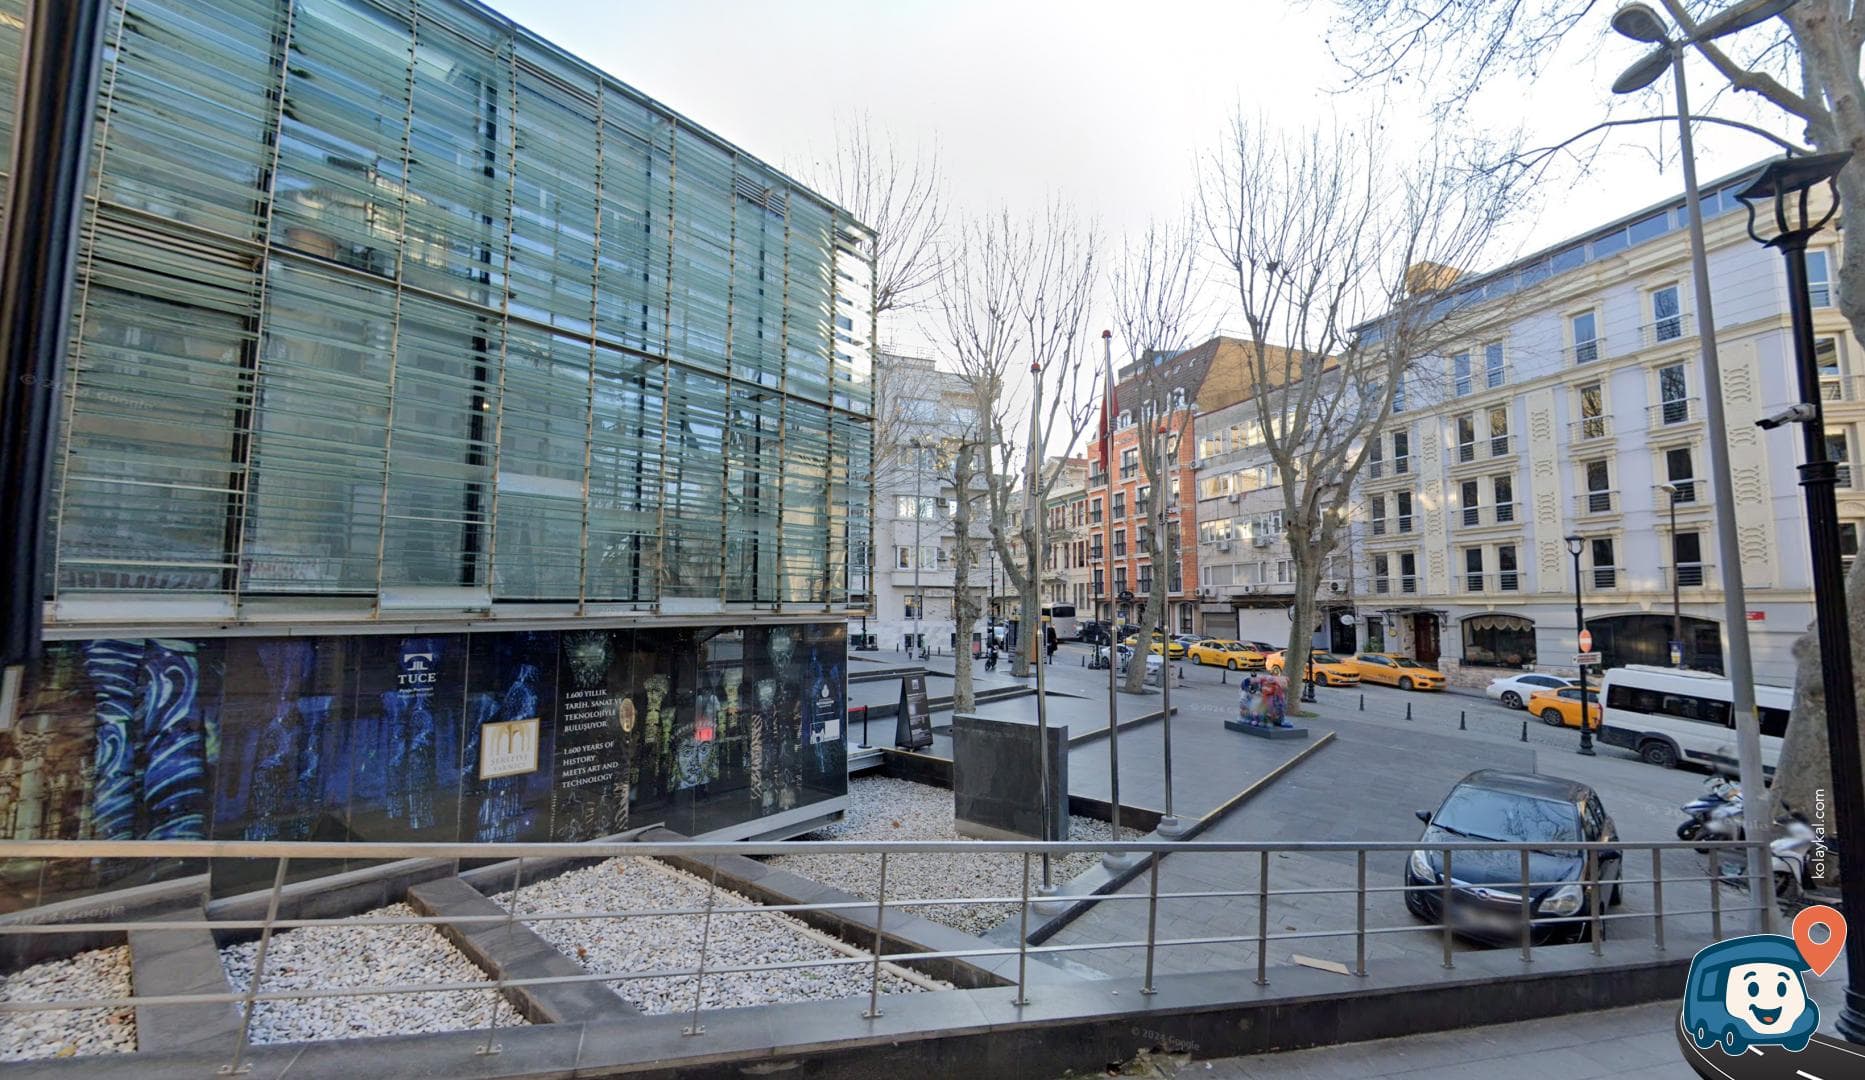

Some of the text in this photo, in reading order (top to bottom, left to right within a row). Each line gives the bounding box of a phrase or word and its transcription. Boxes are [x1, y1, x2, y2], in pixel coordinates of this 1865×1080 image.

[566, 689, 607, 699] 1.600 YILLIK
[591, 699, 612, 707] SANAT
[563, 740, 615, 755] 1.600 YEARS OF
[563, 755, 597, 766] HISTORY
[562, 761, 619, 777] MEETS ART AND
[562, 773, 613, 788] TECHNOLOGY
